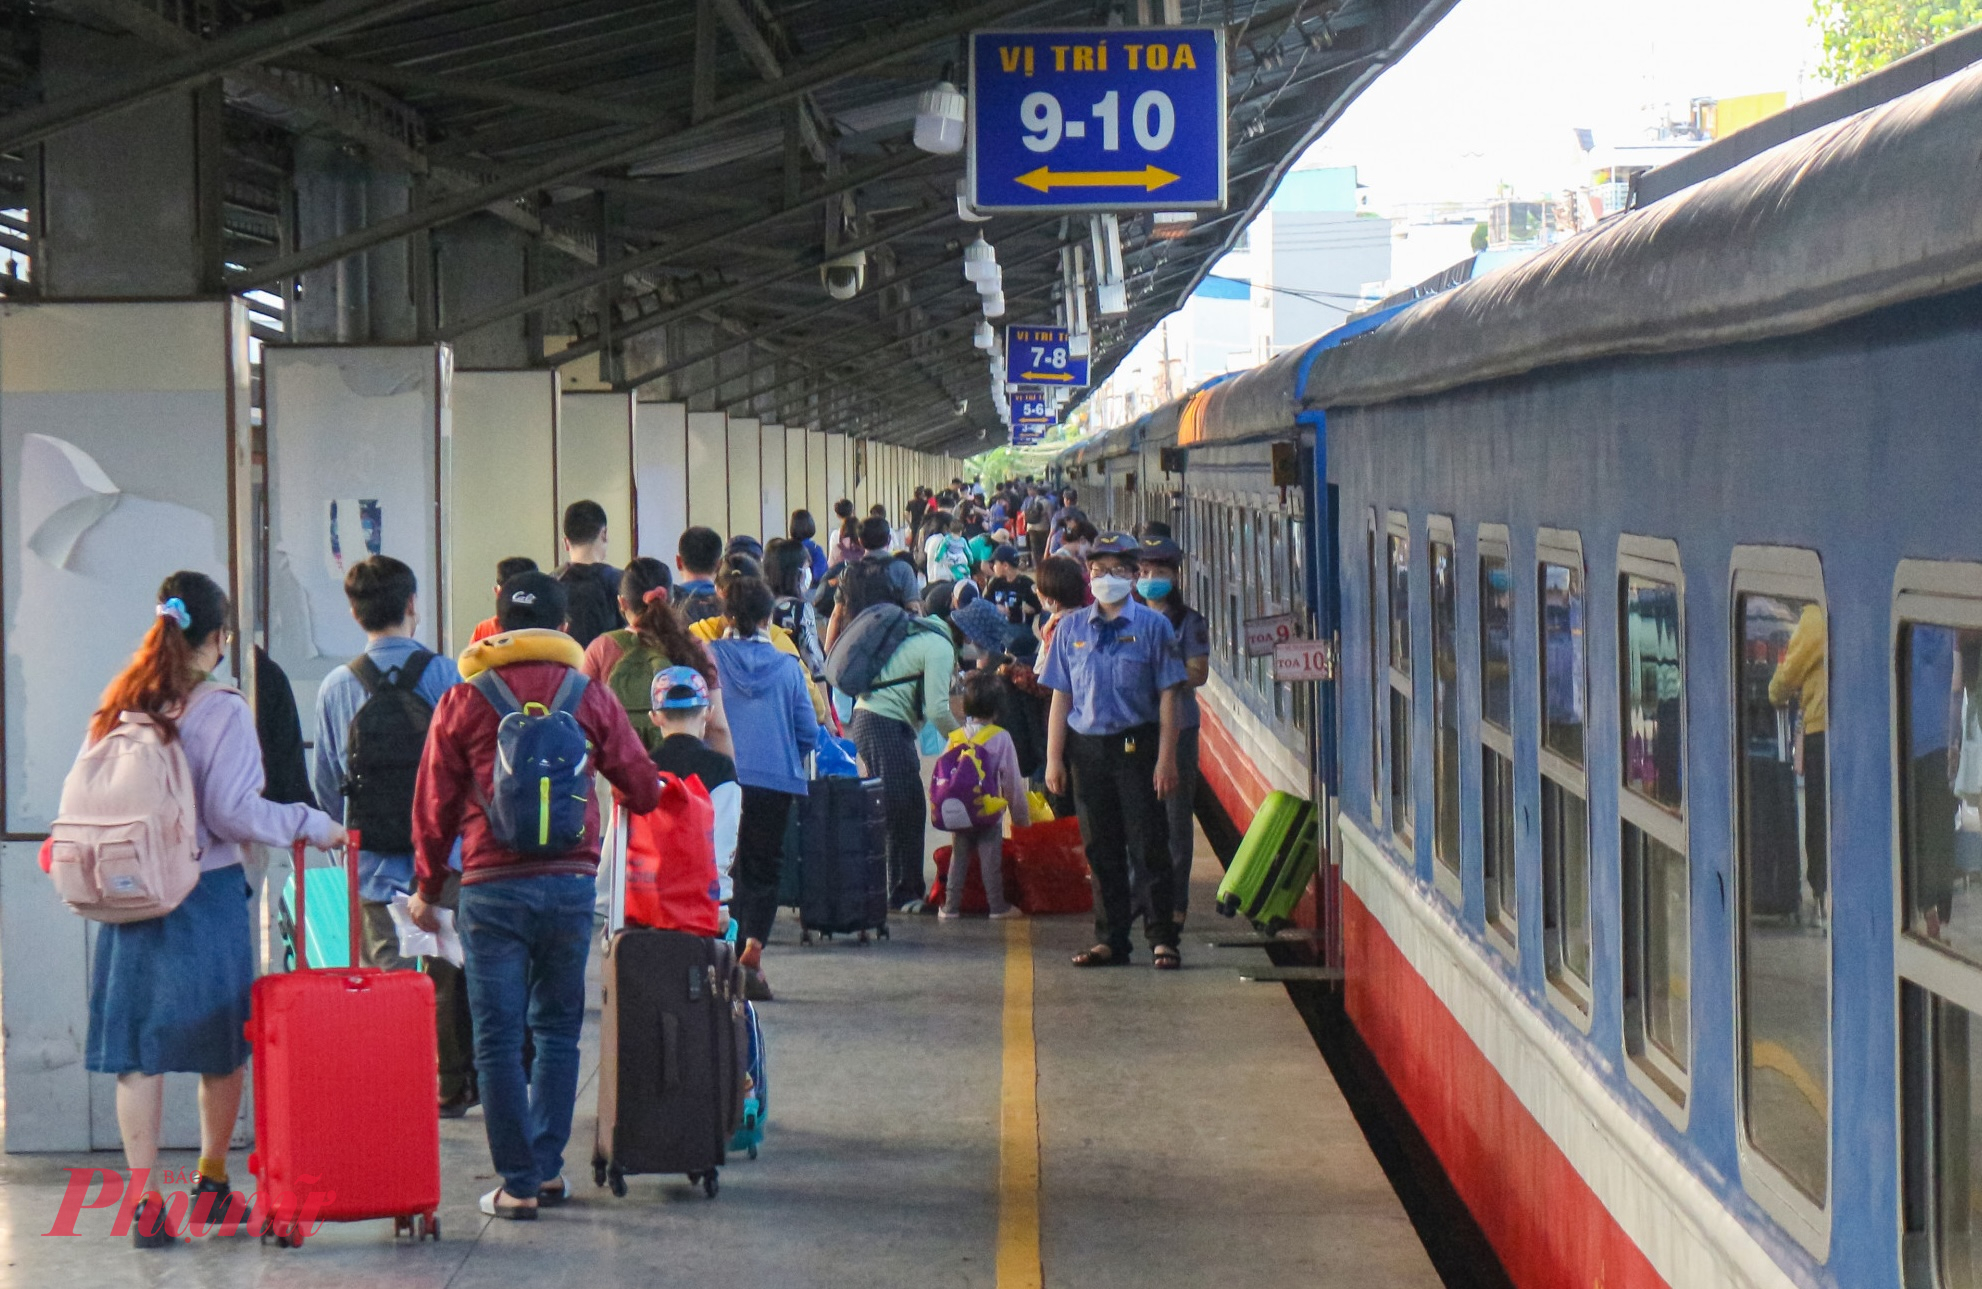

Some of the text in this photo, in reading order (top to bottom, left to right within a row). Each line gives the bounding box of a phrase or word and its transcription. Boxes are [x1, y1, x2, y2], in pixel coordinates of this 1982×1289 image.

[999, 40, 1197, 77] VỊ TRÍ TOA
[1020, 90, 1175, 153] 9-10
[1031, 346, 1067, 369] 7-8
[1023, 403, 1044, 416] 5-6
[1248, 624, 1290, 644] TOA 9
[1277, 651, 1325, 671] TOA 10
